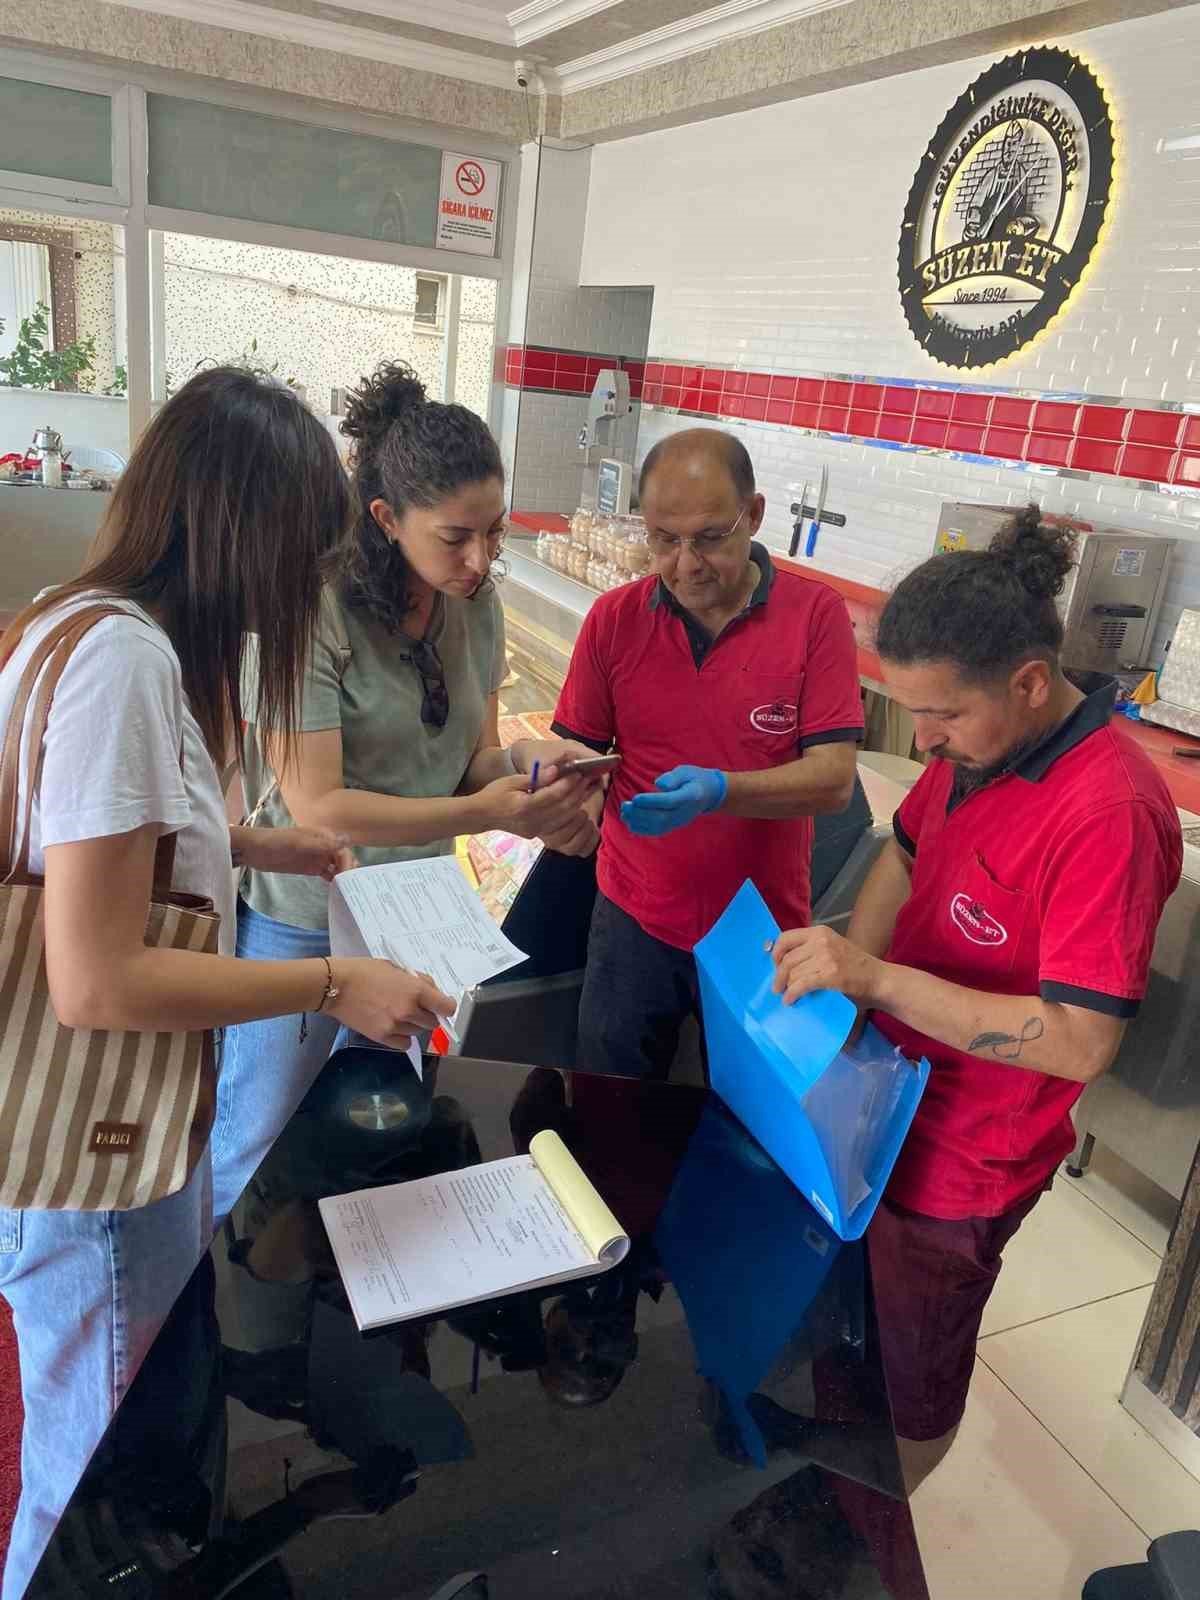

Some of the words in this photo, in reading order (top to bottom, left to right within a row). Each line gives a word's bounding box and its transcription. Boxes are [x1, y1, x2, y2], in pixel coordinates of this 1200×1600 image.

[922, 240, 1062, 291] SÜZEN-ET
[953, 288, 980, 303] Since
[981, 287, 1008, 302] 1994
